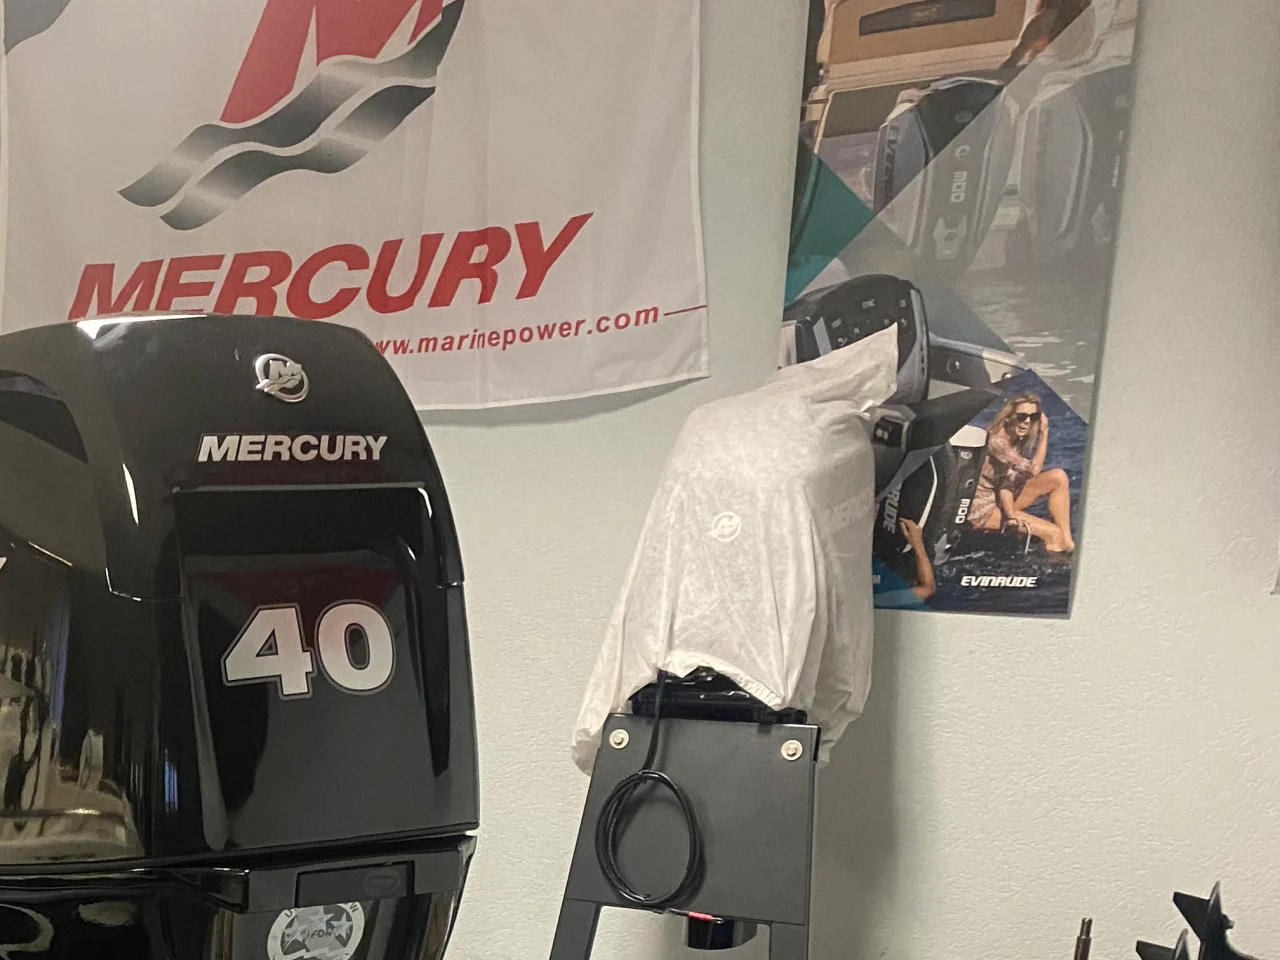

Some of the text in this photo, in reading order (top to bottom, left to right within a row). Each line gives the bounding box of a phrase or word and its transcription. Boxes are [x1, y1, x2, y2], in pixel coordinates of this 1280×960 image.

[68, 212, 595, 320] MERCURY
[375, 304, 660, 356] ww.marinepower.com
[197, 433, 388, 463] MERCURY
[960, 575, 1038, 588] EVINRUDE
[220, 600, 396, 701] 40
